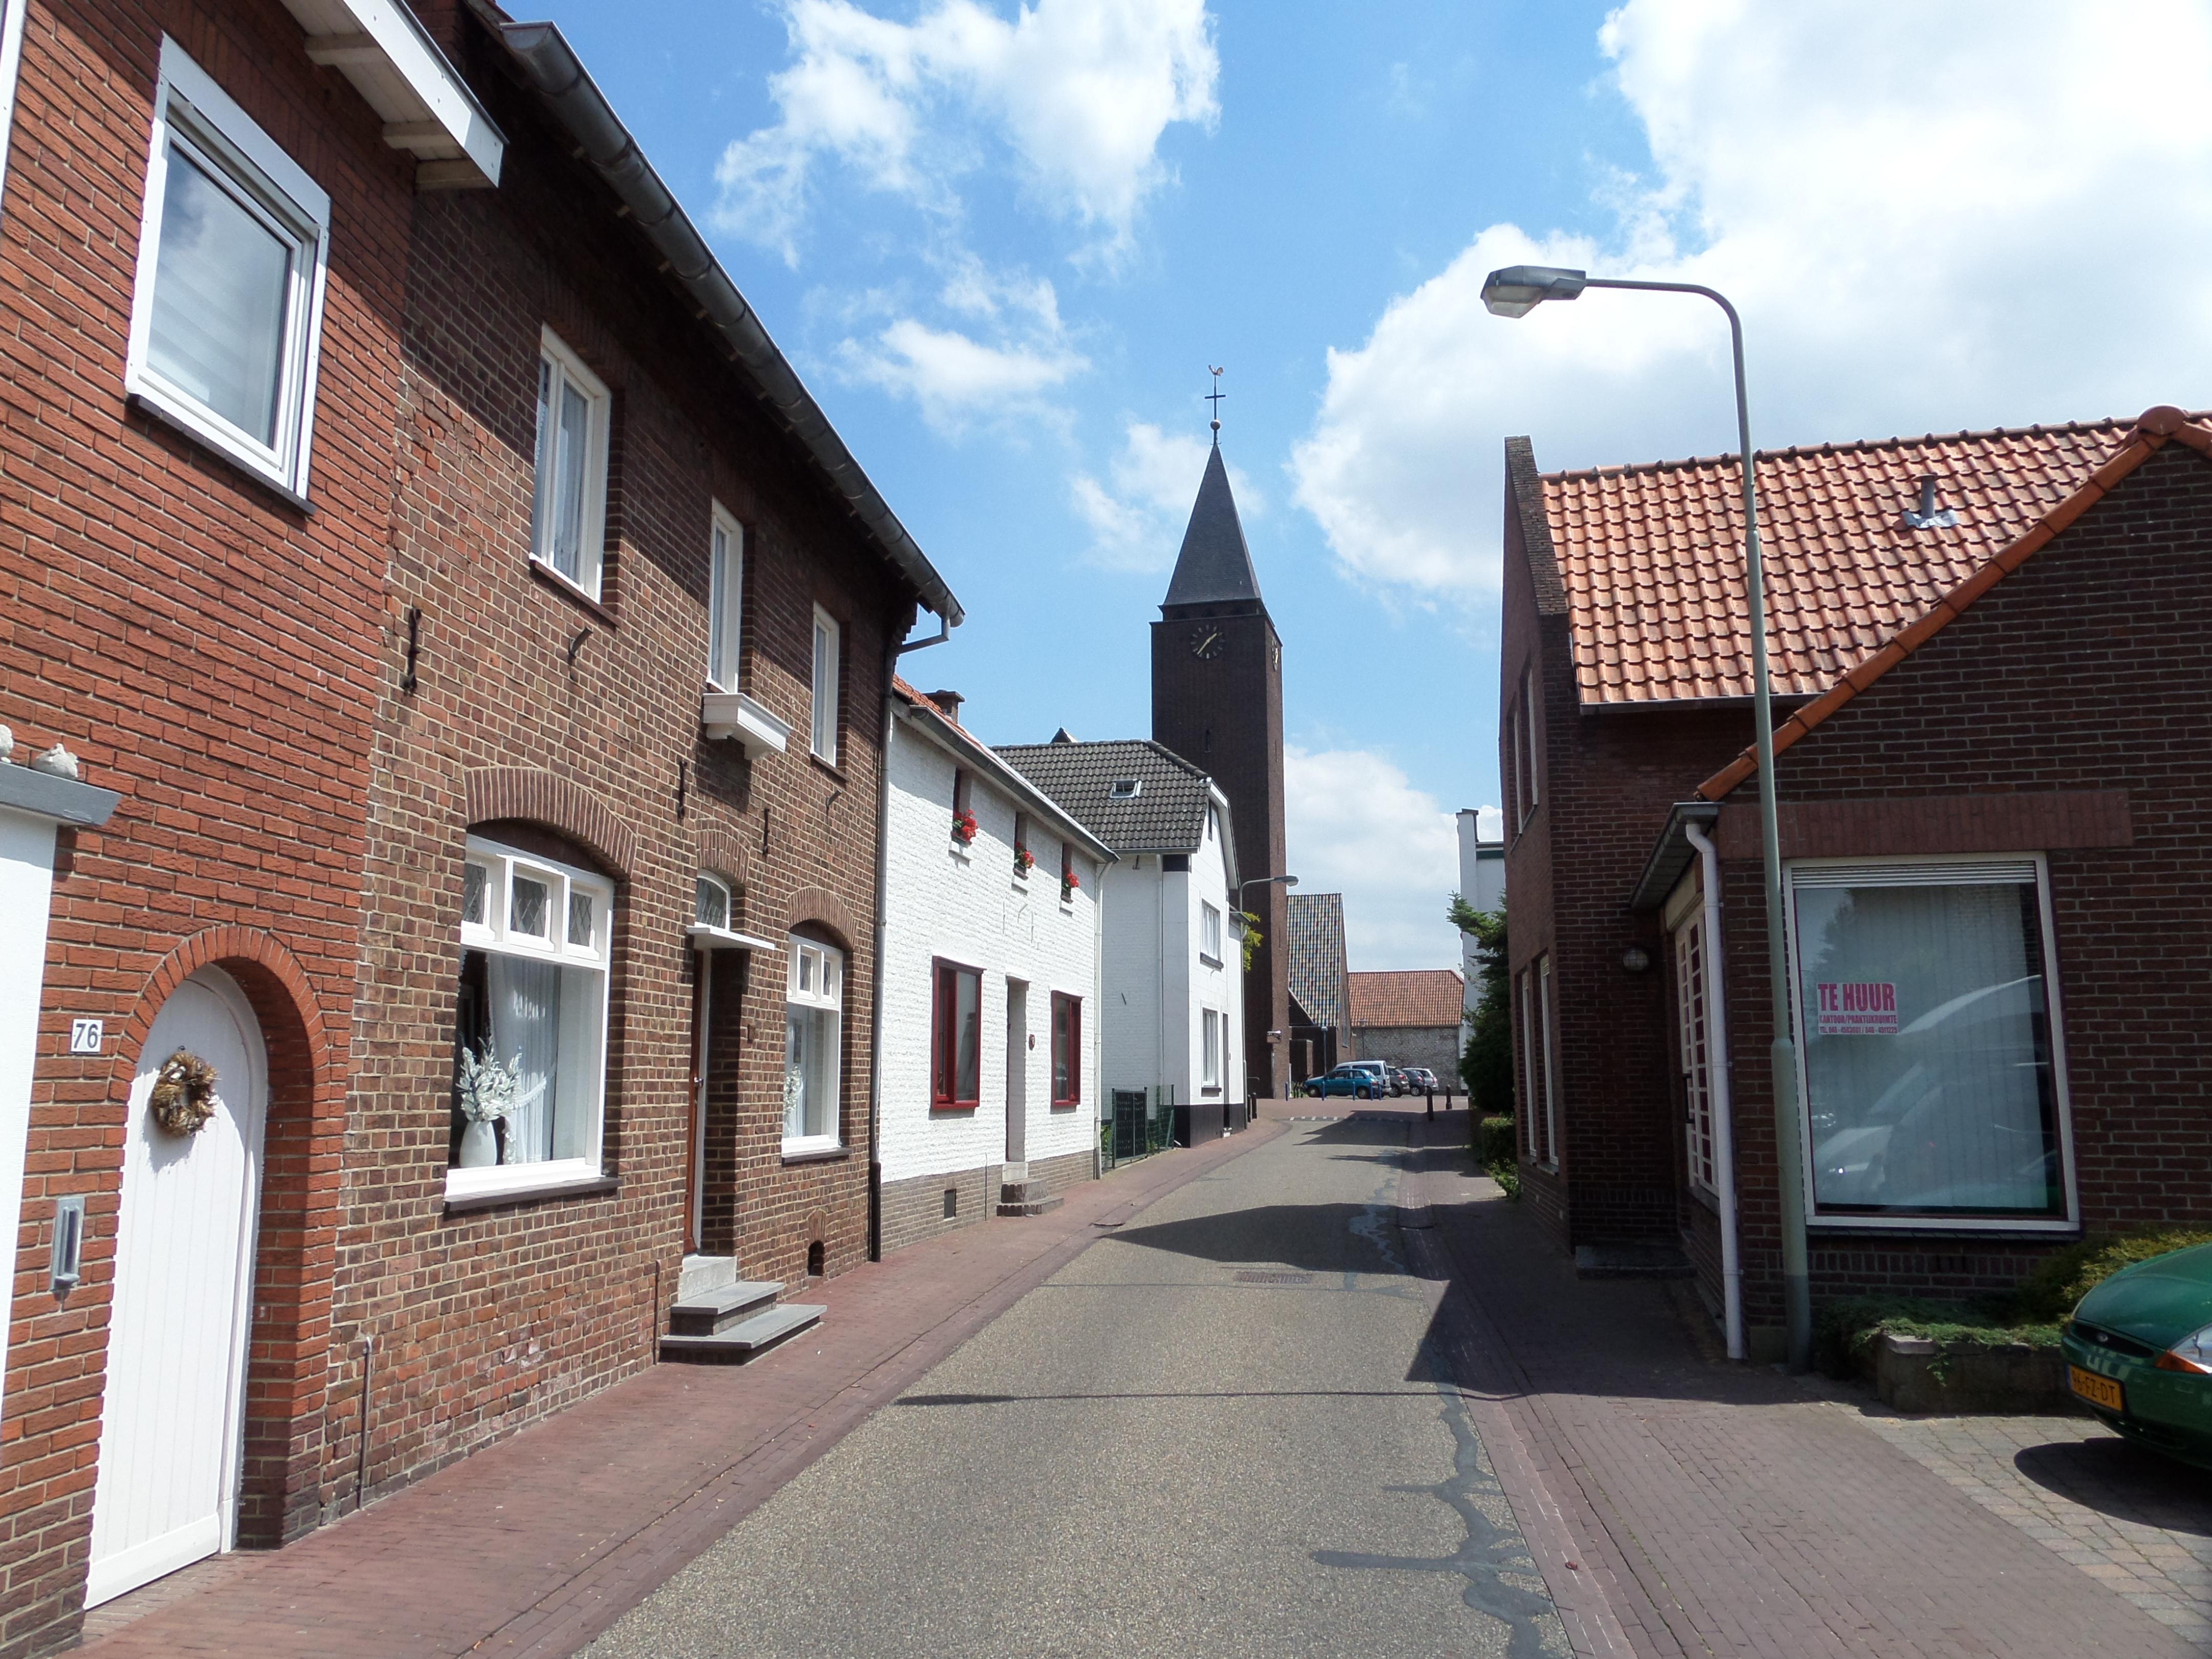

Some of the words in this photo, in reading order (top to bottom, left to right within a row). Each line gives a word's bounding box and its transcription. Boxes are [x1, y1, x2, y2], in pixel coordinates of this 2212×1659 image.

[1818, 983, 1839, 1011] TE
[1843, 983, 1895, 1012] HUUR
[74, 1023, 98, 1049] 76
